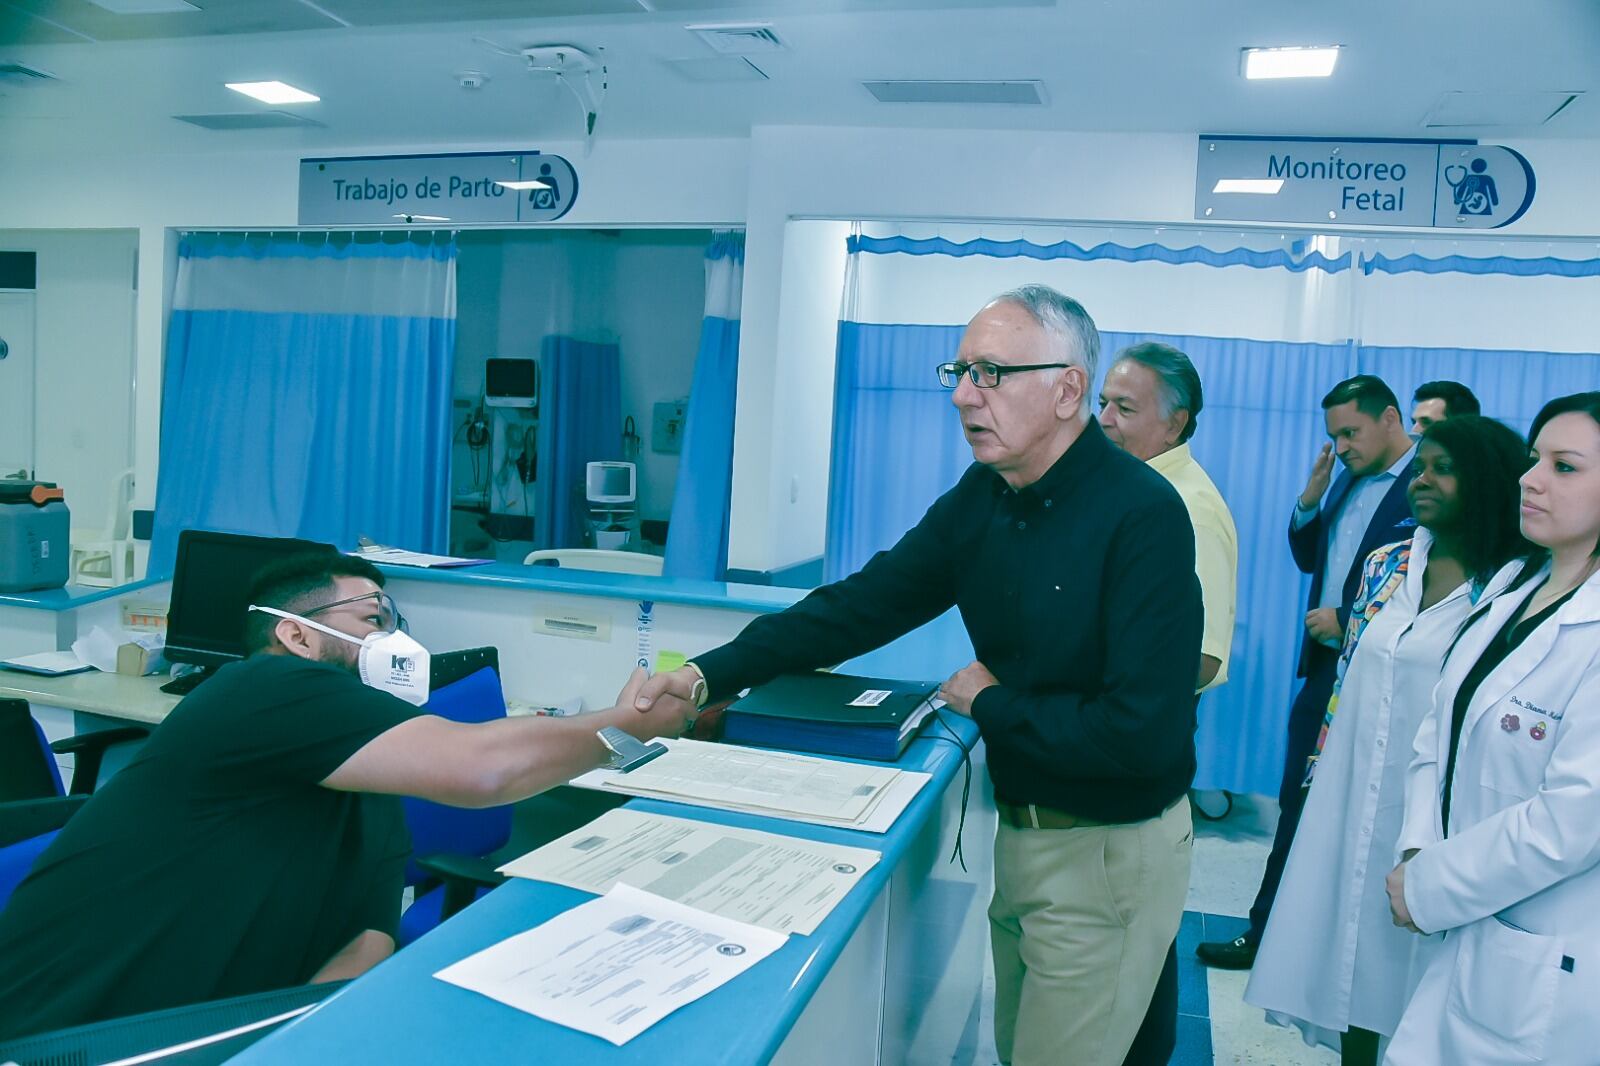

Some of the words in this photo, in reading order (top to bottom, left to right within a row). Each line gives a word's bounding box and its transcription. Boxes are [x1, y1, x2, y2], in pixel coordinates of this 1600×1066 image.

[1268, 154, 1406, 181] Monitoreo
[333, 177, 408, 205] Trabajo
[415, 176, 441, 199] de
[450, 176, 505, 198] Parto
[1342, 186, 1404, 211] Fetal
